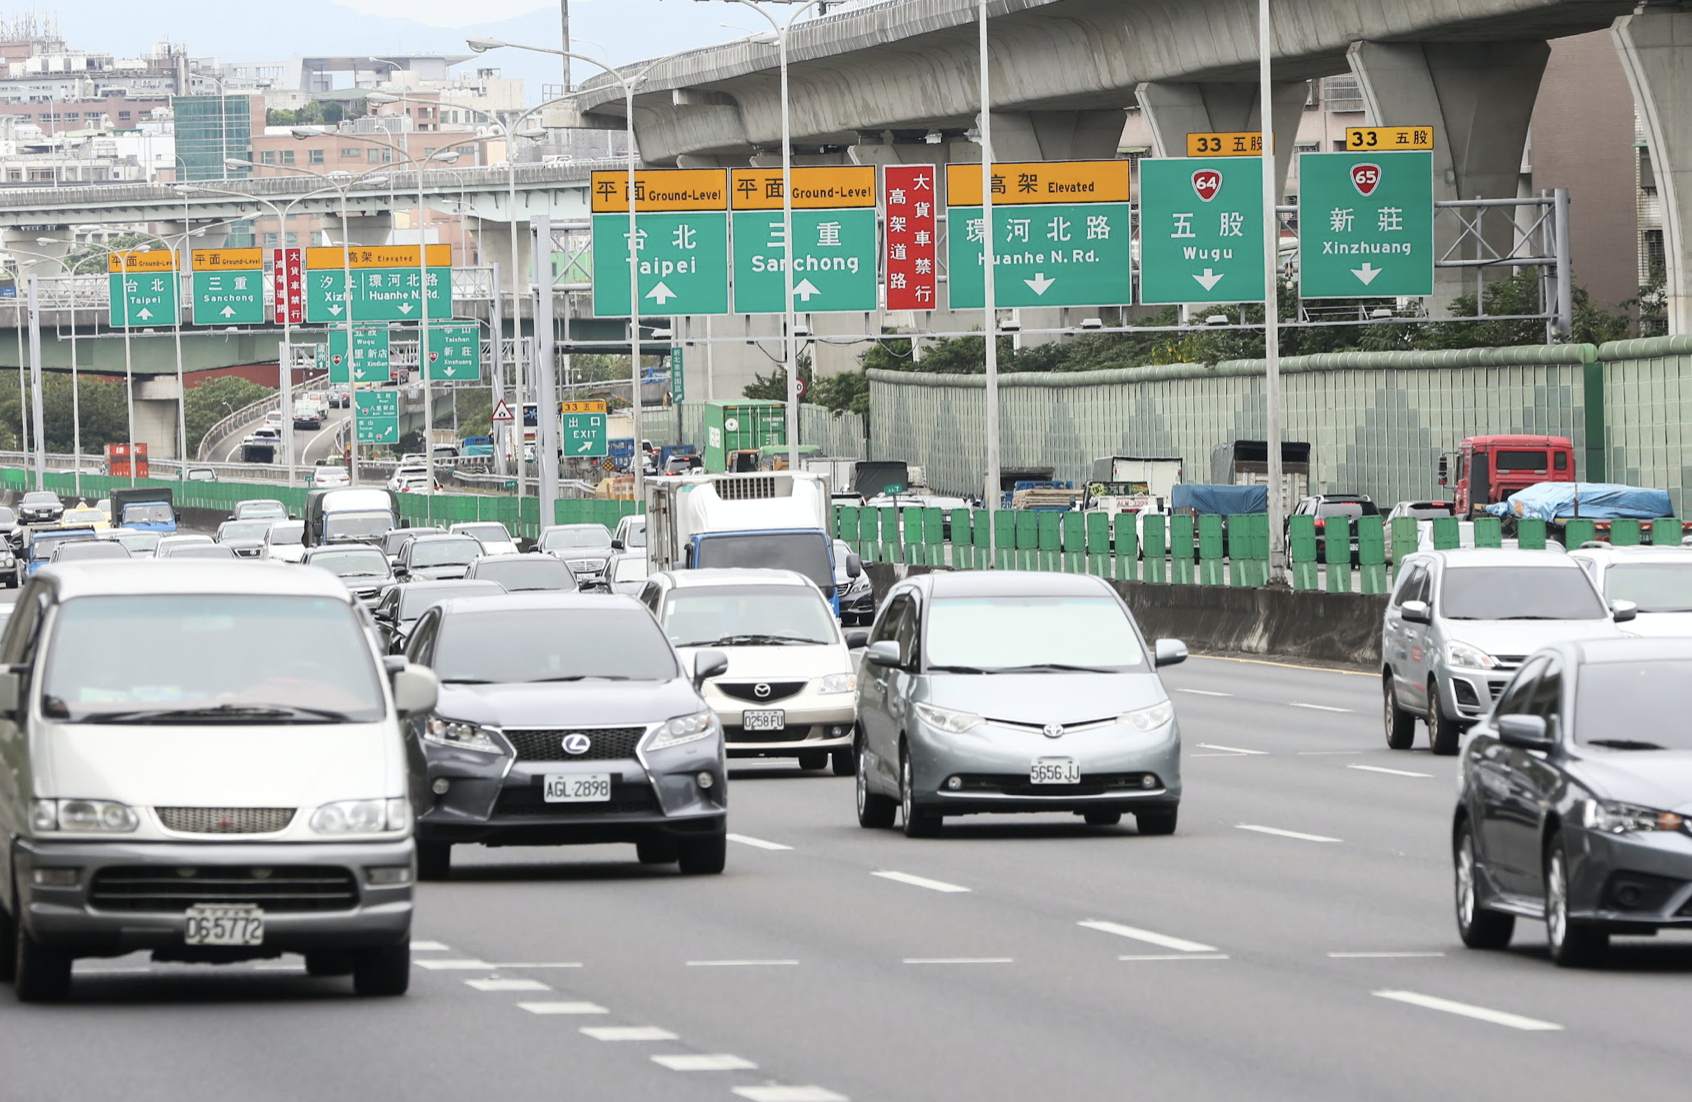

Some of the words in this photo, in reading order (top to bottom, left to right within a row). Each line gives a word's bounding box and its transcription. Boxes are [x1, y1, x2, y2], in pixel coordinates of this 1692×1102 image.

[1197, 137, 1222, 152] 33
[1232, 136, 1263, 152] 五股
[1352, 131, 1378, 147] 33
[1396, 130, 1428, 144] 五股
[991, 173, 1039, 194] 高架
[1048, 181, 1095, 193] Elevated
[1196, 176, 1217, 190] 64
[1355, 170, 1377, 184] 65
[596, 180, 646, 202] 平面
[648, 189, 721, 202] Ground-Level
[737, 178, 784, 199] 平面
[792, 186, 871, 199] Ground-Level
[1170, 211, 1244, 238] 五股
[1330, 206, 1402, 232] 新莊
[766, 220, 842, 248] 三重
[966, 214, 1111, 243] 環河北路
[623, 224, 697, 250] 台北
[889, 187, 907, 290] 高架道路
[913, 173, 932, 303] 大貨車禁行
[1183, 246, 1233, 262] Wugu
[1322, 240, 1411, 256] Xinzhuang
[111, 255, 137, 268] 平面
[194, 253, 220, 266] 平面
[222, 258, 261, 266] Ground-Level
[348, 250, 372, 263] 高架
[377, 255, 413, 263] Elevated
[1051, 250, 1068, 264] N.
[1073, 249, 1100, 263] Rd.
[126, 277, 165, 293] 台北
[209, 276, 248, 291] 三重
[290, 251, 301, 319] 大貨車禁行
[368, 273, 438, 288] 環河北路
[130, 295, 161, 305] Taipei
[203, 293, 254, 303] Sanchong
[369, 290, 408, 301] Huanhe
[565, 403, 578, 411] 33
[568, 416, 601, 428] 出口
[573, 429, 597, 439] EXIT
